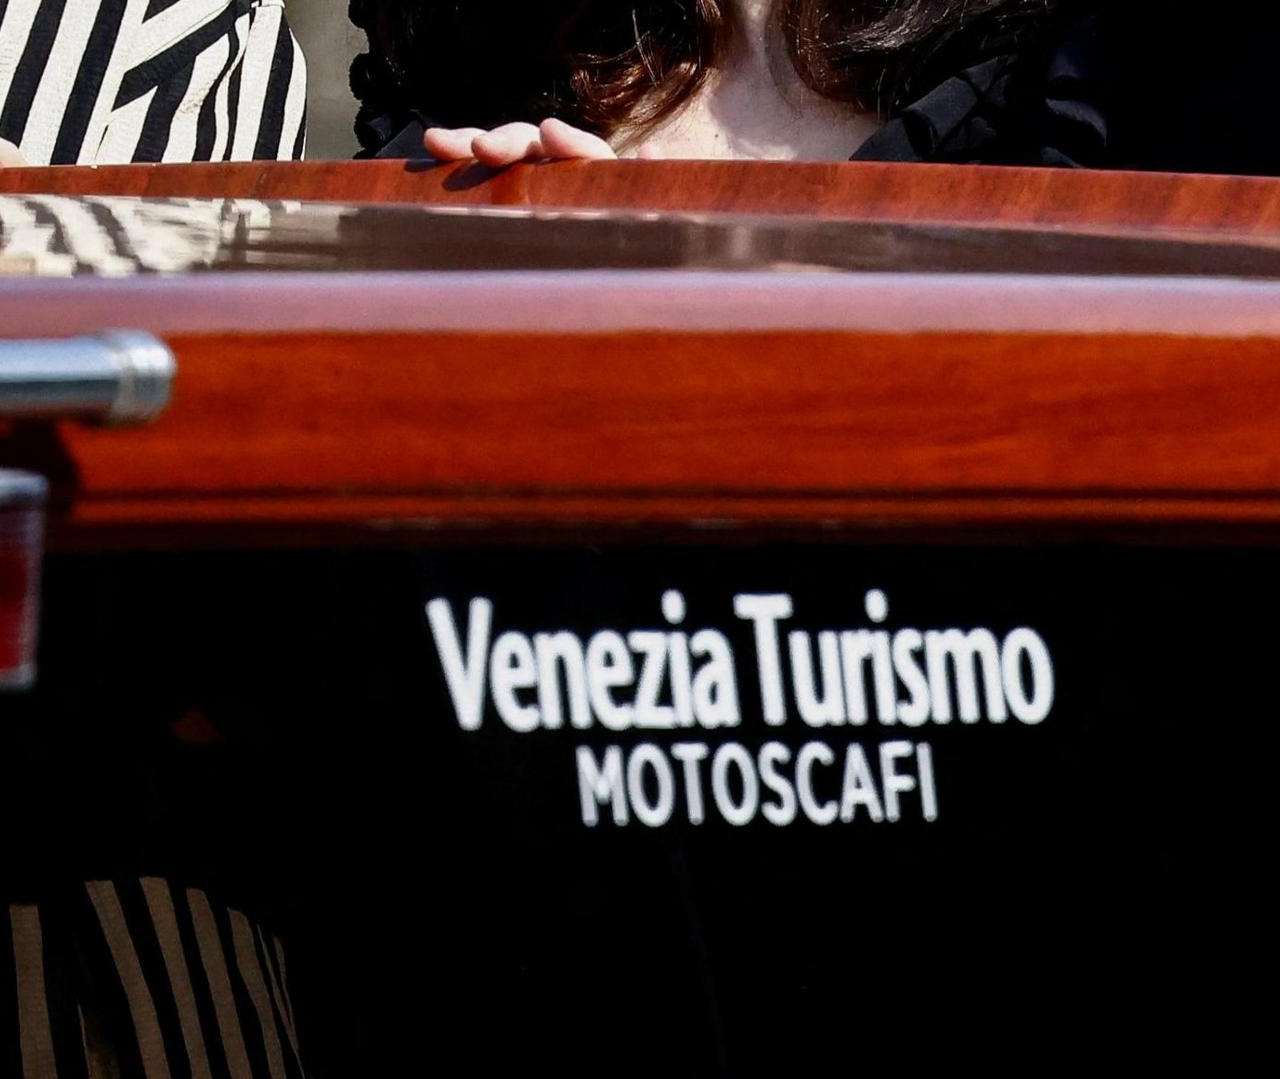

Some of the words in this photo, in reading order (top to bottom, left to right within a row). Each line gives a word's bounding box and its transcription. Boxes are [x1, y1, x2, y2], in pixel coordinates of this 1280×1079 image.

[426, 590, 741, 732] Venezia
[733, 589, 1054, 728] Turismo
[575, 741, 938, 827] MOTOSCAFI
